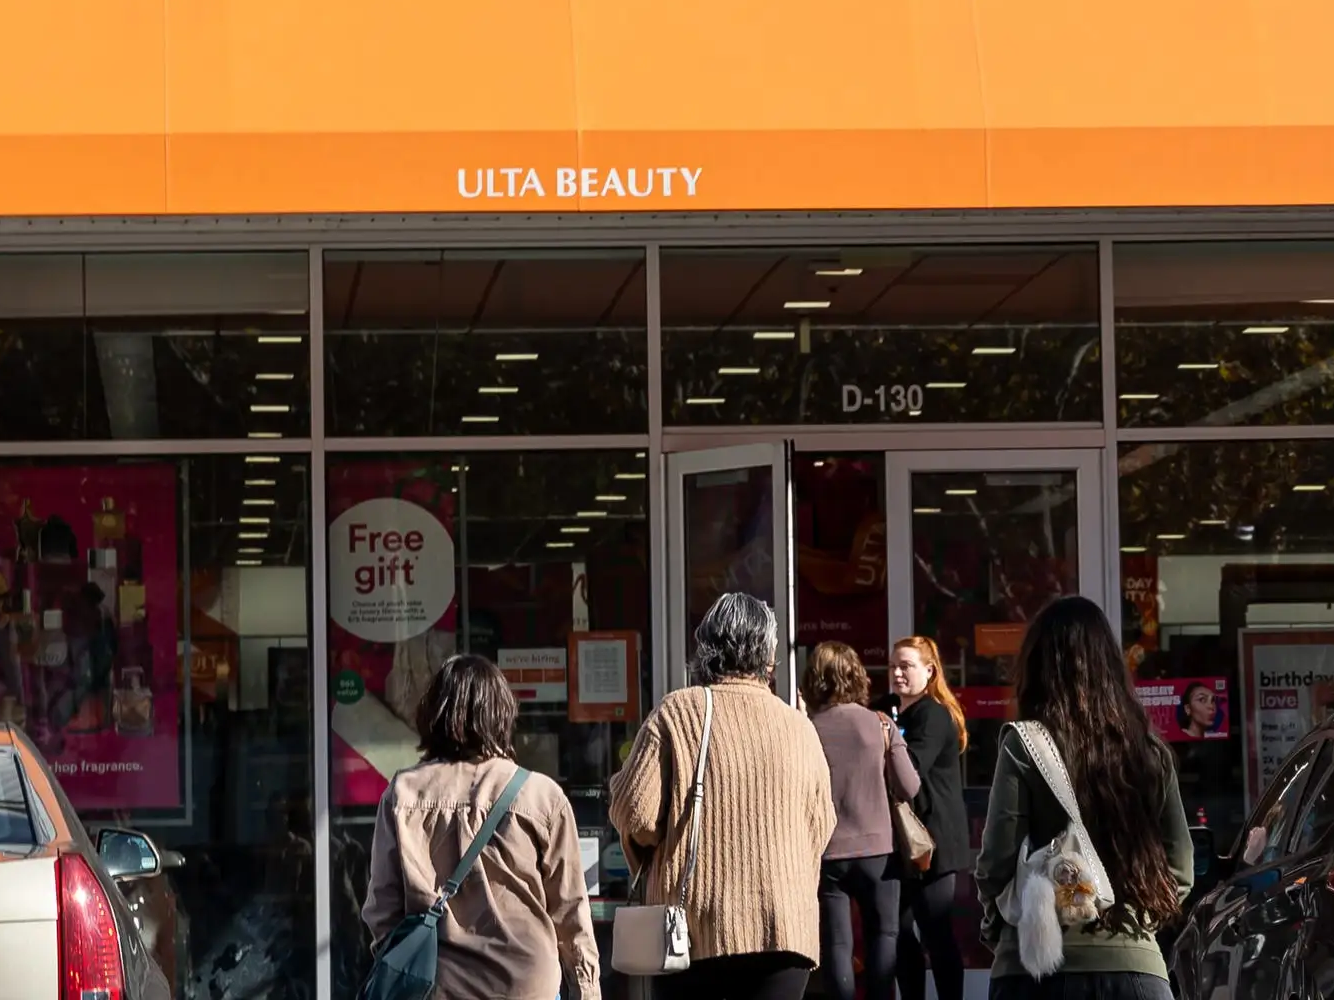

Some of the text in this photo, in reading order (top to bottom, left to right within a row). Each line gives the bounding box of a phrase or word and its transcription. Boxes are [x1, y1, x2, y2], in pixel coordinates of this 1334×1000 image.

[457, 167, 702, 198] ULTA BEAUTY
[841, 384, 924, 413] D-130
[348, 523, 424, 553] Free
[1261, 690, 1297, 708] love
[80, 759, 144, 775] fragrance.
